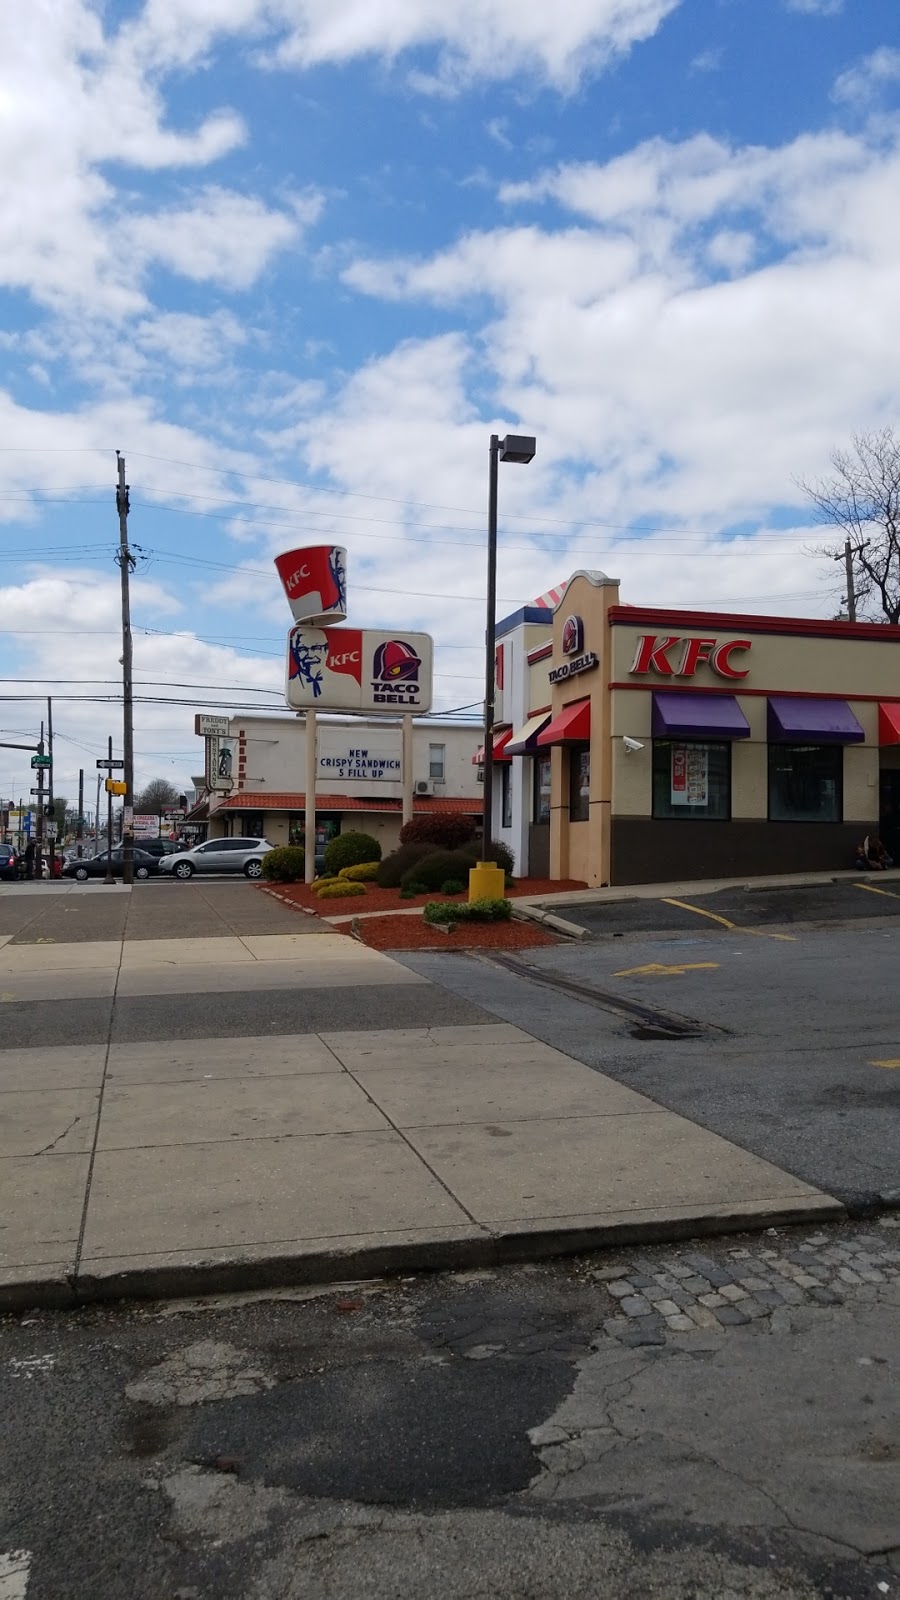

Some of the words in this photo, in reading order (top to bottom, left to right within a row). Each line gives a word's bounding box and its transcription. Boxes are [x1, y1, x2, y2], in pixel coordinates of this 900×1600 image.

[286, 564, 311, 591] KFC
[329, 651, 360, 667] KFC
[630, 635, 752, 679] KFC
[548, 664, 569, 682] TACO
[569, 653, 592, 673] BELL
[370, 682, 420, 694] TACO
[373, 694, 420, 705] BELL
[201, 716, 228, 725] FREDDY
[203, 727, 226, 735] TONY'S
[349, 749, 368, 758] NEW
[320, 758, 353, 767] CRISPY
[355, 759, 401, 769] SANDWICH
[339, 768, 344, 777] 5
[348, 769, 367, 777] FILL
[372, 770, 384, 778] UP
